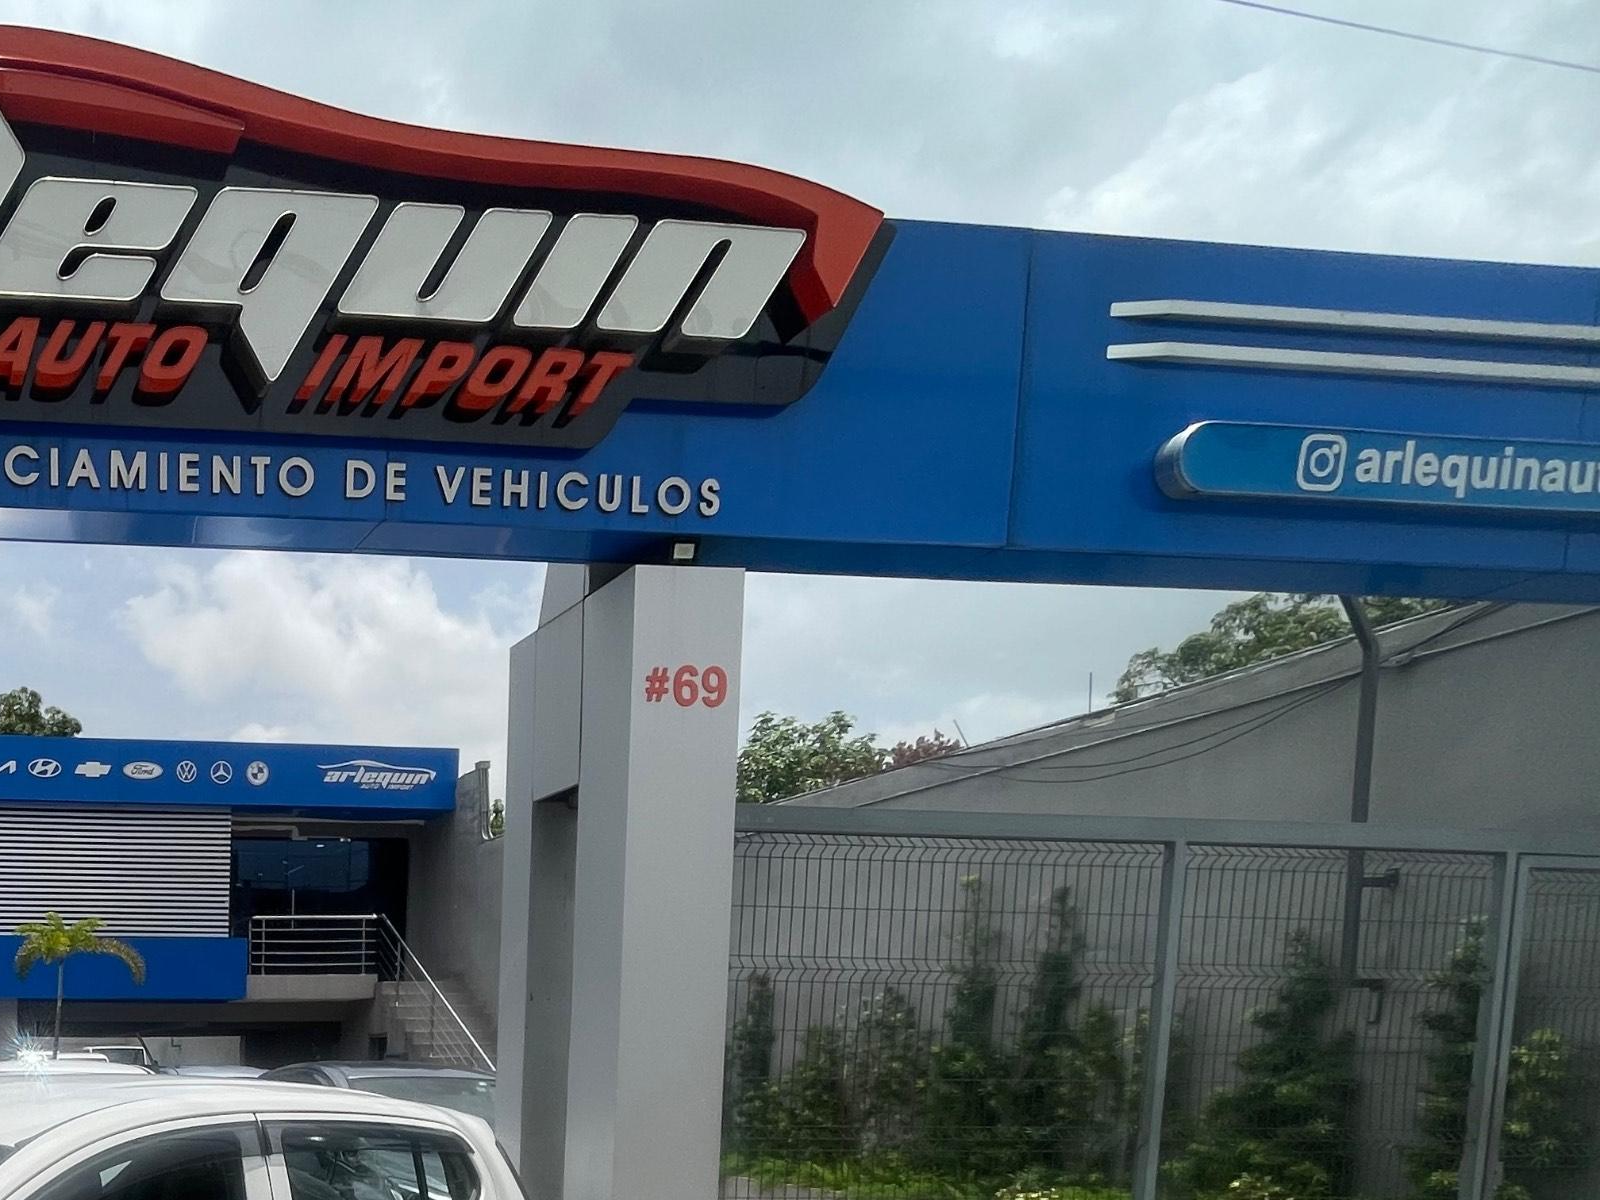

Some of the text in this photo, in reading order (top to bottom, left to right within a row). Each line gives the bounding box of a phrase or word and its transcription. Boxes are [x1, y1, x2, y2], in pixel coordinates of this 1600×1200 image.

[296, 333, 637, 416] IMPORT
[345, 458, 408, 503] DE
[435, 464, 722, 517] VEHICULOS
[1355, 439, 1600, 498] arlequinau
[644, 663, 729, 709] #69
[323, 766, 431, 789] arlequin
